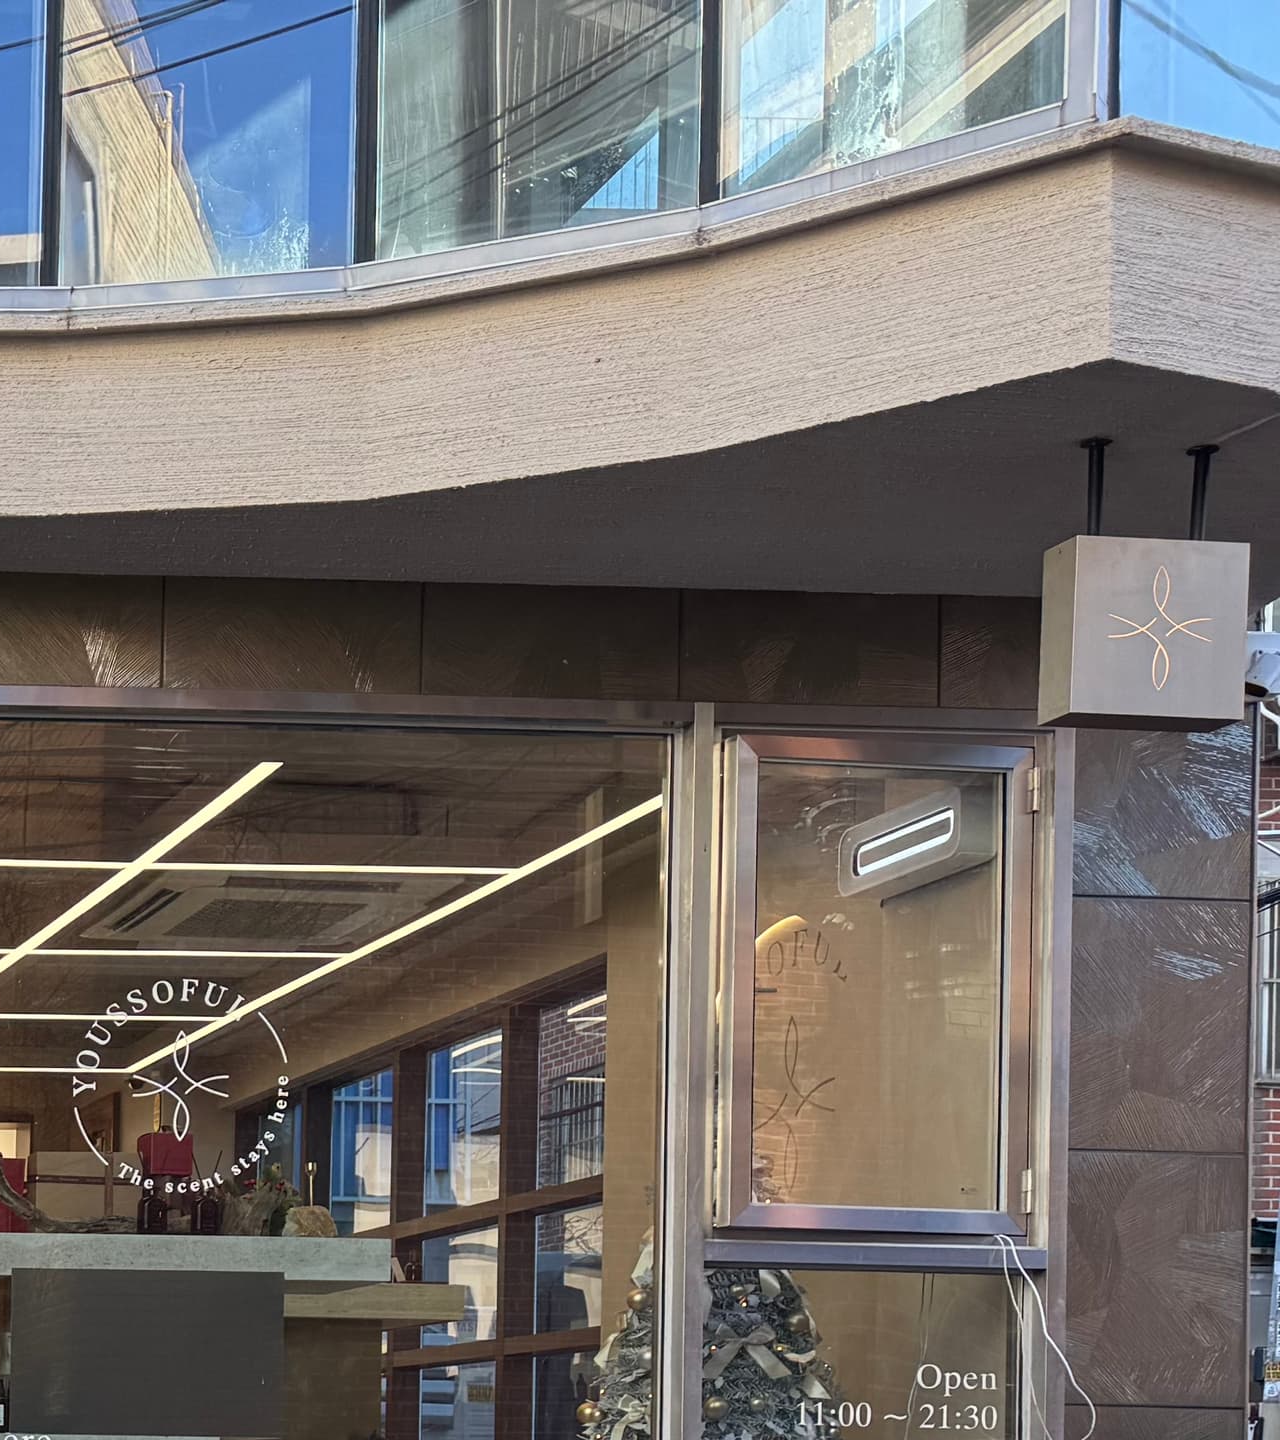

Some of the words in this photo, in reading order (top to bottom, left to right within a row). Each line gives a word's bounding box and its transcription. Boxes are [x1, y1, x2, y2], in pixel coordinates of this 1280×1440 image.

[72, 978, 246, 1098] YOUSSOFUL
[118, 1162, 155, 1190] The
[164, 1172, 224, 1194] scent
[230, 1131, 275, 1176] stays
[267, 1075, 290, 1124] here
[796, 1401, 873, 1428] 11:00
[919, 1404, 999, 1430] 21:30
[916, 1363, 998, 1397] Open
